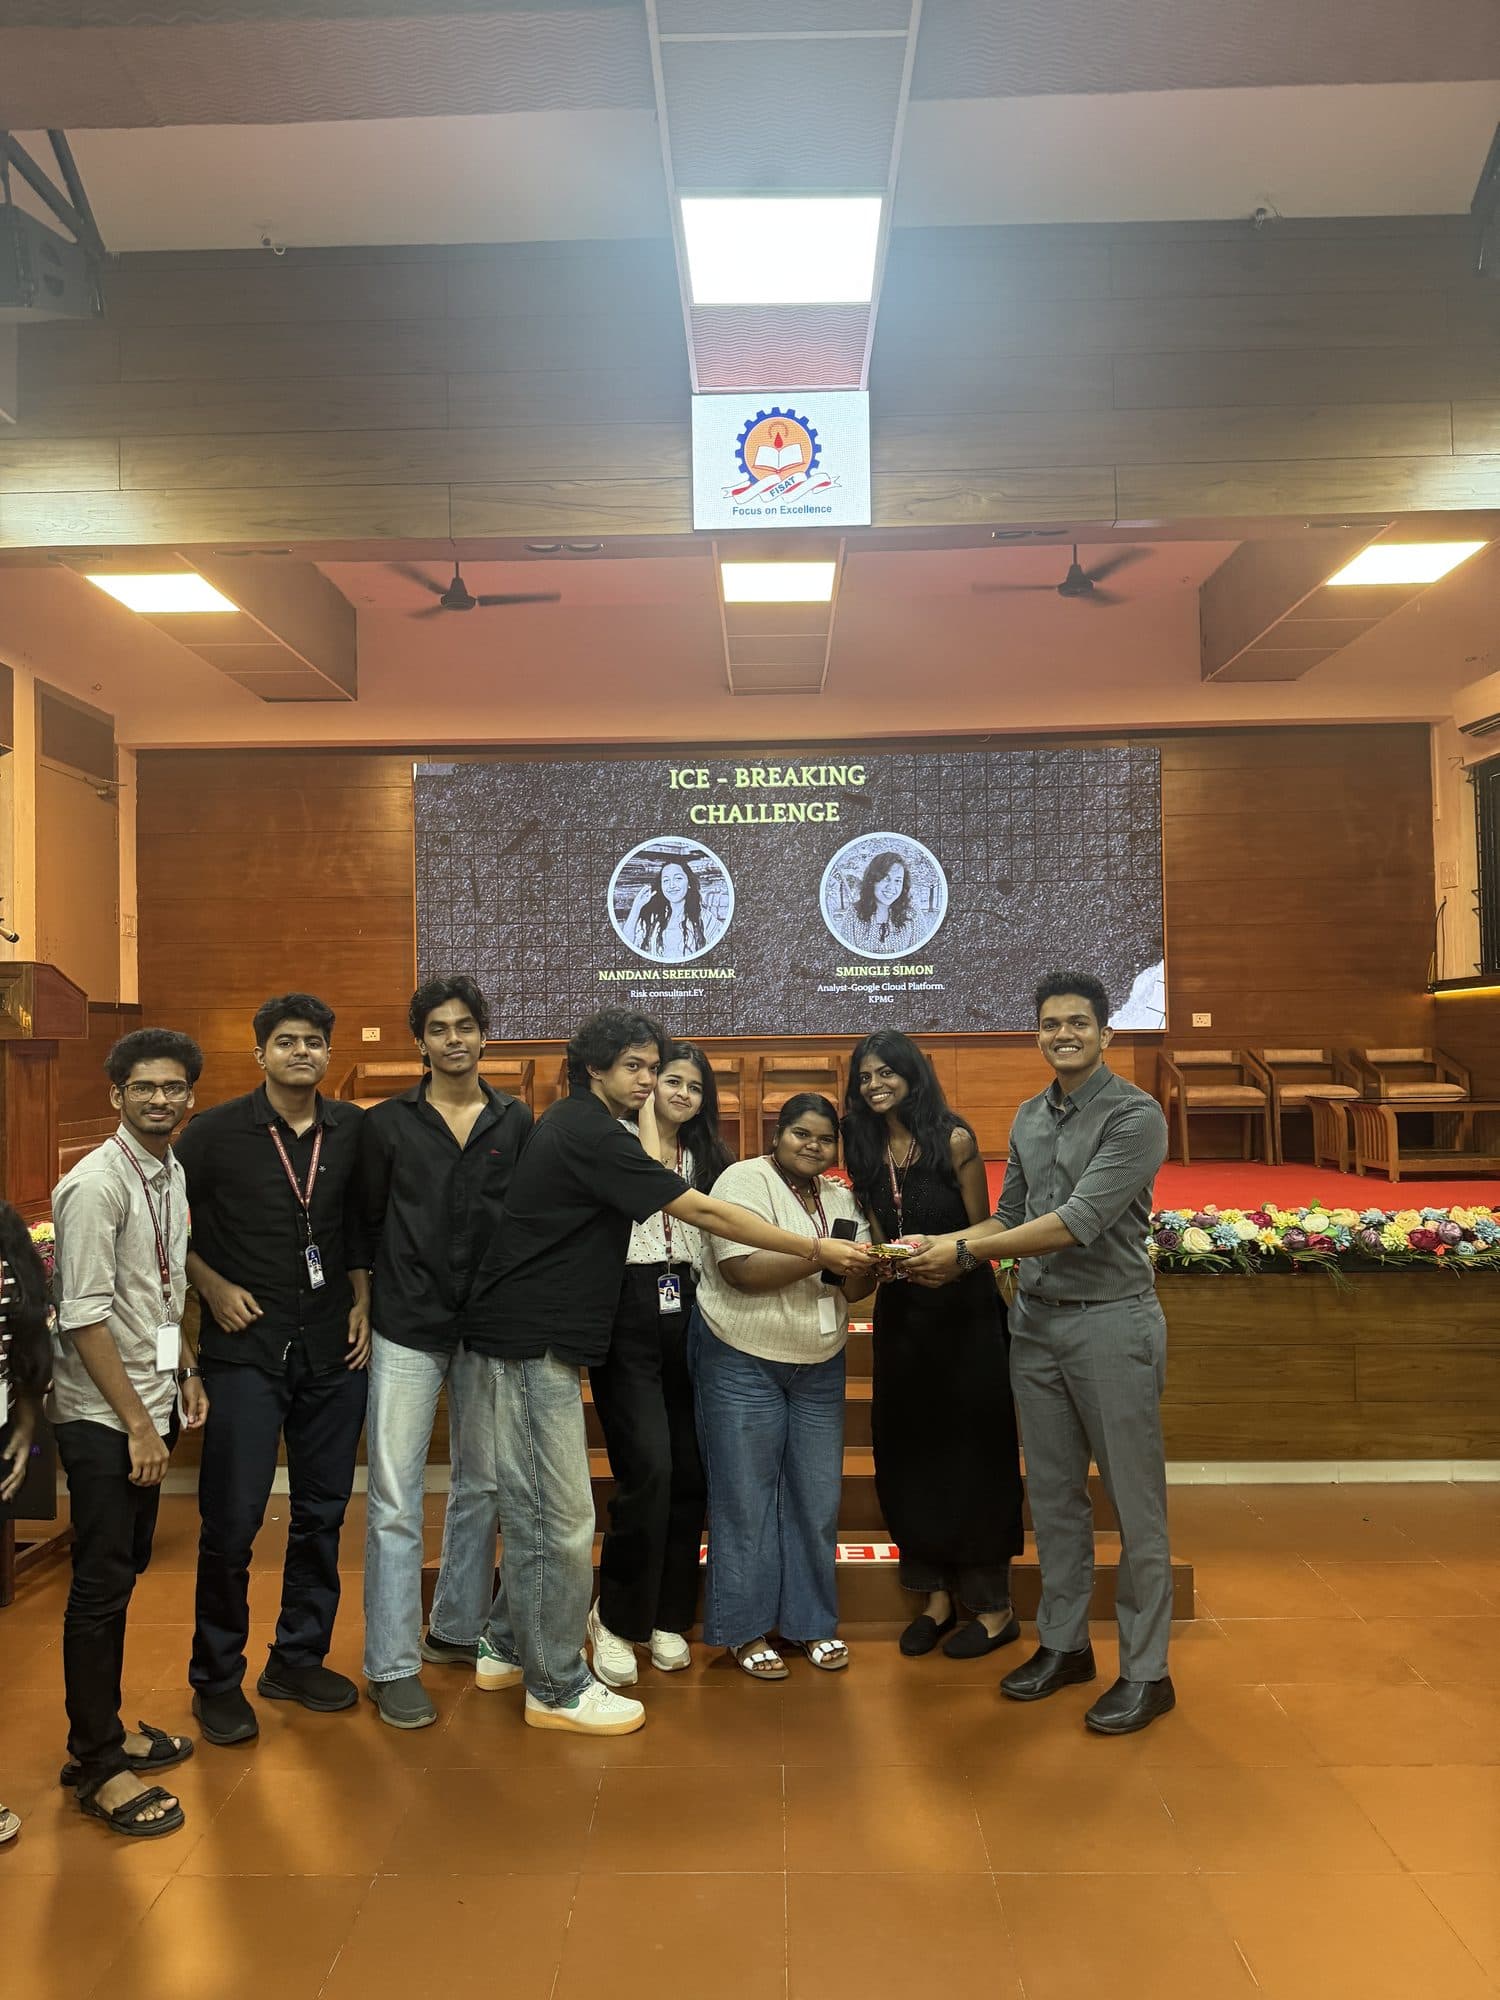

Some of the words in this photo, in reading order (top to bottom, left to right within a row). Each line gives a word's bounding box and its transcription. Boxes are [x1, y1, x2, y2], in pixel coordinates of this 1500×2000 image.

[769, 476, 796, 497] FISAT
[732, 506, 762, 515] Focus
[765, 507, 777, 515] on
[780, 504, 832, 514] Excellence
[669, 768, 710, 789] ICE
[735, 765, 867, 788] BREAKING
[690, 802, 840, 824] CHALLENGE
[599, 970, 660, 980] NANDANA
[662, 969, 736, 979] SREEKUMAR
[836, 966, 890, 977] SMINGLE
[893, 965, 934, 975] SIMON
[881, 983, 906, 991] Cloud
[868, 995, 894, 1003] KPMG
